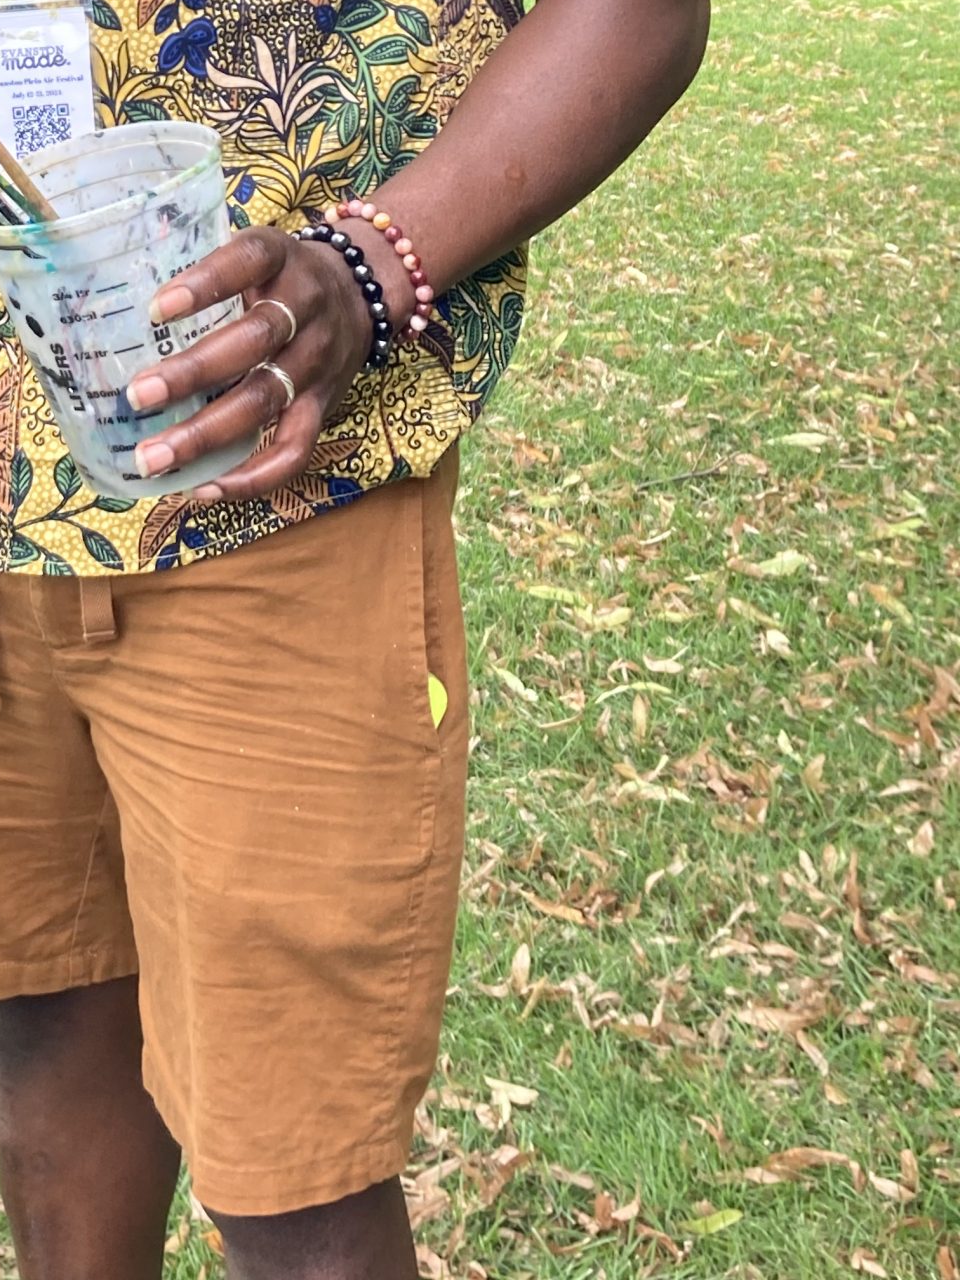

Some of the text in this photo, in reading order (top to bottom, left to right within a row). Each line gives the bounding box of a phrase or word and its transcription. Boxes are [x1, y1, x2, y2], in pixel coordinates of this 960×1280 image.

[1, 45, 64, 58] EVANSTON
[184, 323, 211, 341] 16 oz
[74, 352, 94, 361] 1/2
[97, 416, 114, 425] 1/4
